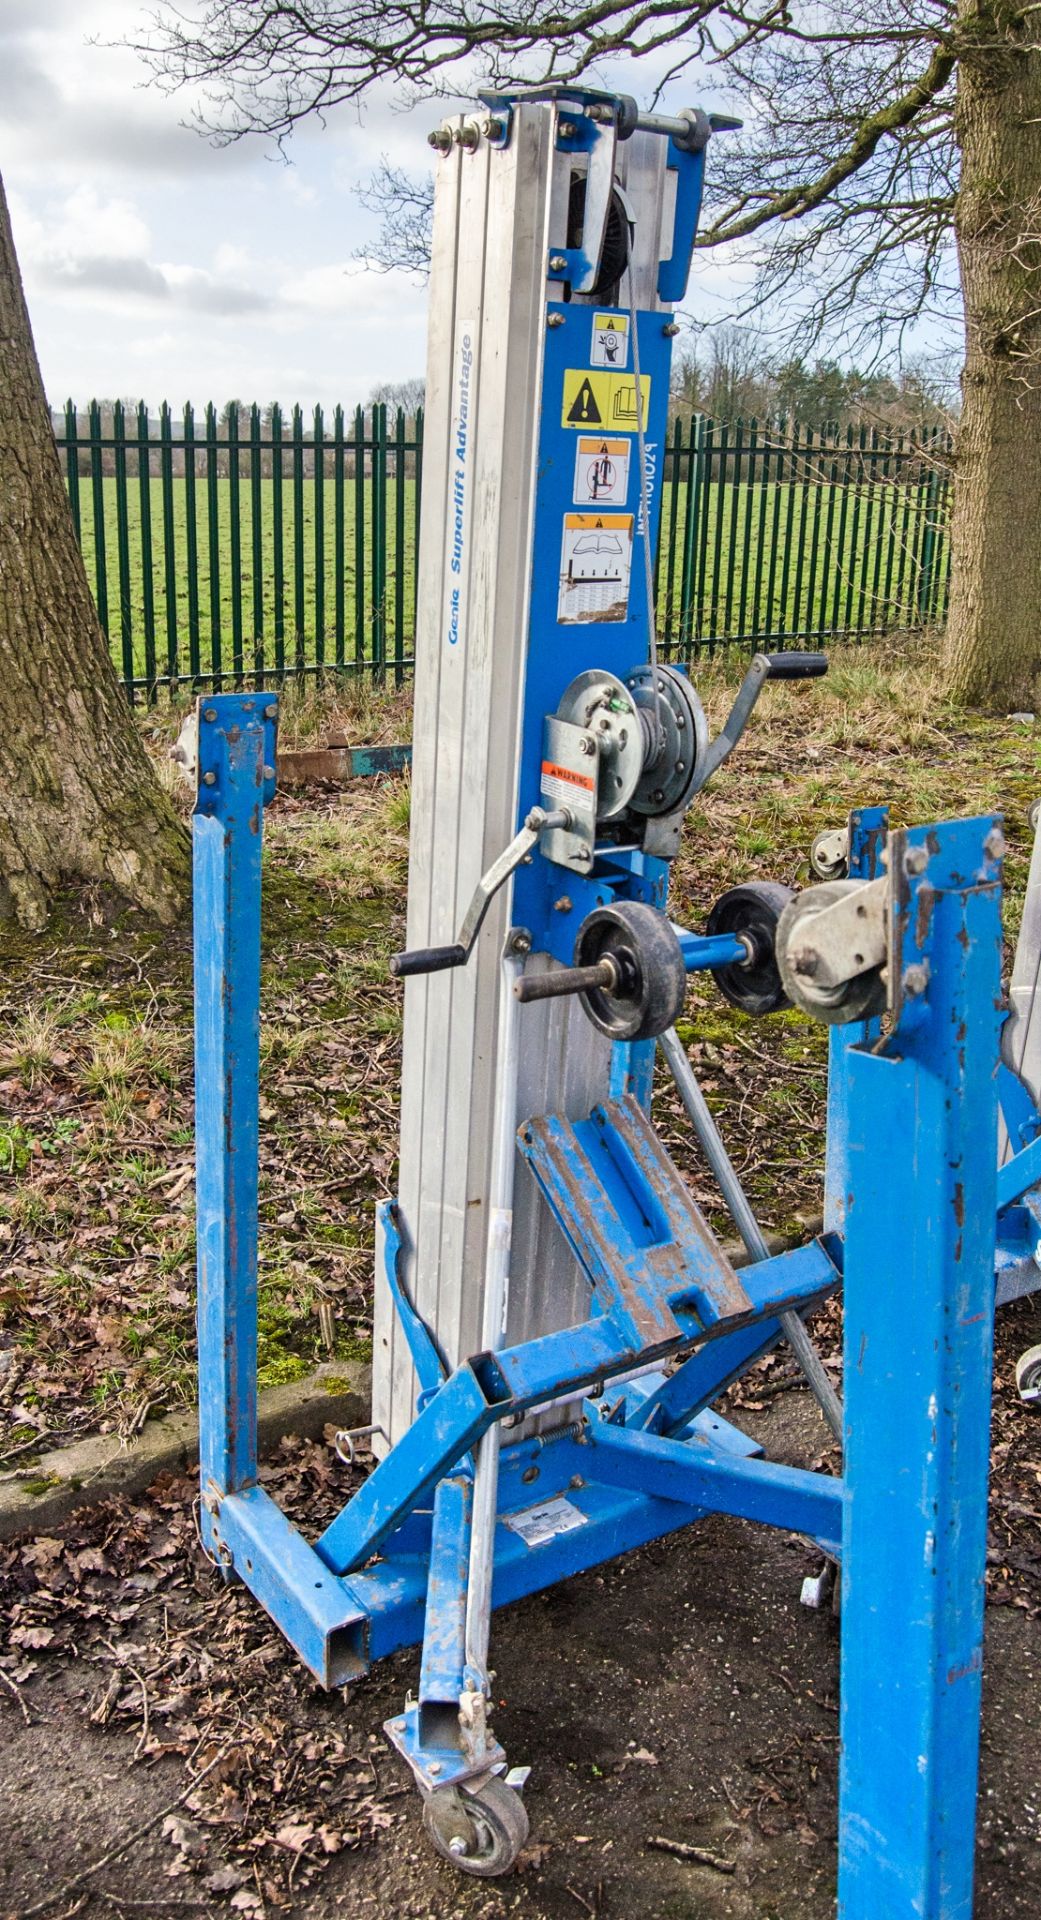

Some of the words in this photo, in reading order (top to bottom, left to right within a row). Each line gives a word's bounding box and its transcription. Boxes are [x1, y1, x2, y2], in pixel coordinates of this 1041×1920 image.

[455, 334, 473, 464] Advantage
[450, 470, 466, 575] Superlift
[447, 589, 460, 645] Genie
[556, 767, 587, 787] WARNING
